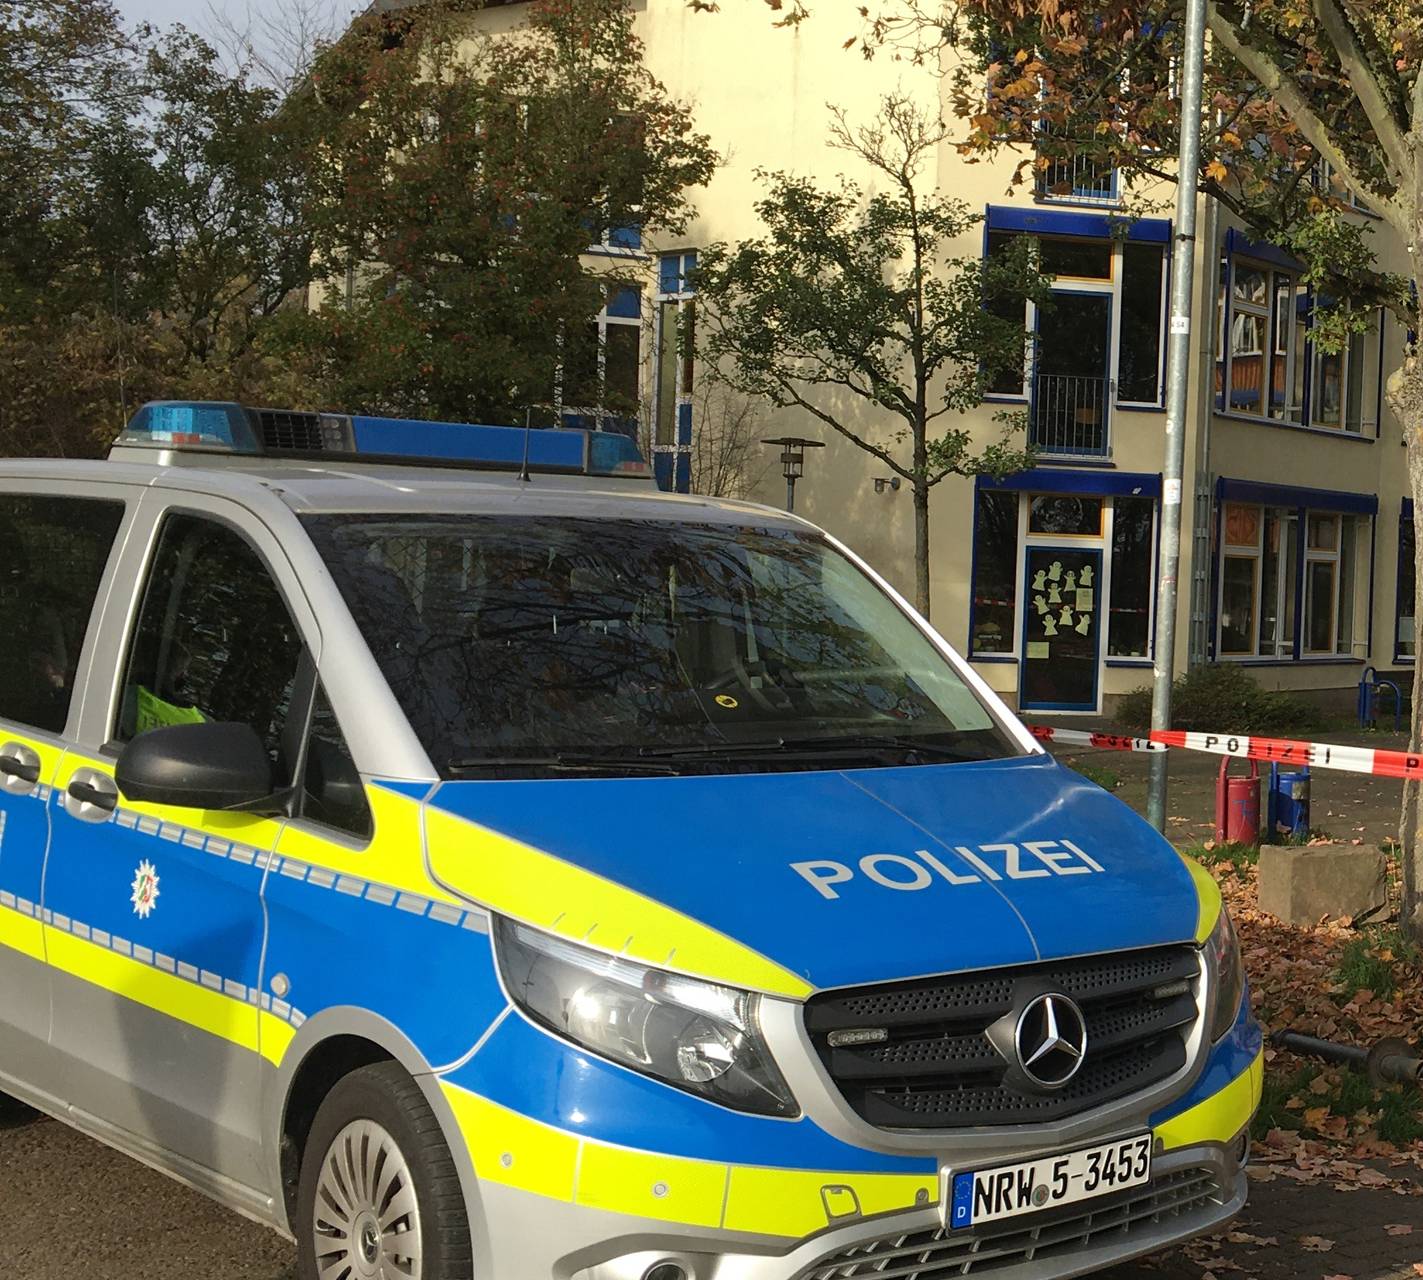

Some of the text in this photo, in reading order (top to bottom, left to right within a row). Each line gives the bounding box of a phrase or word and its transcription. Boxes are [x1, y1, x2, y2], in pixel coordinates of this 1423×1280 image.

[1205, 736, 1331, 764] POLIZEI
[788, 839, 1106, 900] POLIZEI
[973, 1139, 1150, 1218] NRW 5-3453
[957, 1206, 966, 1219] D
